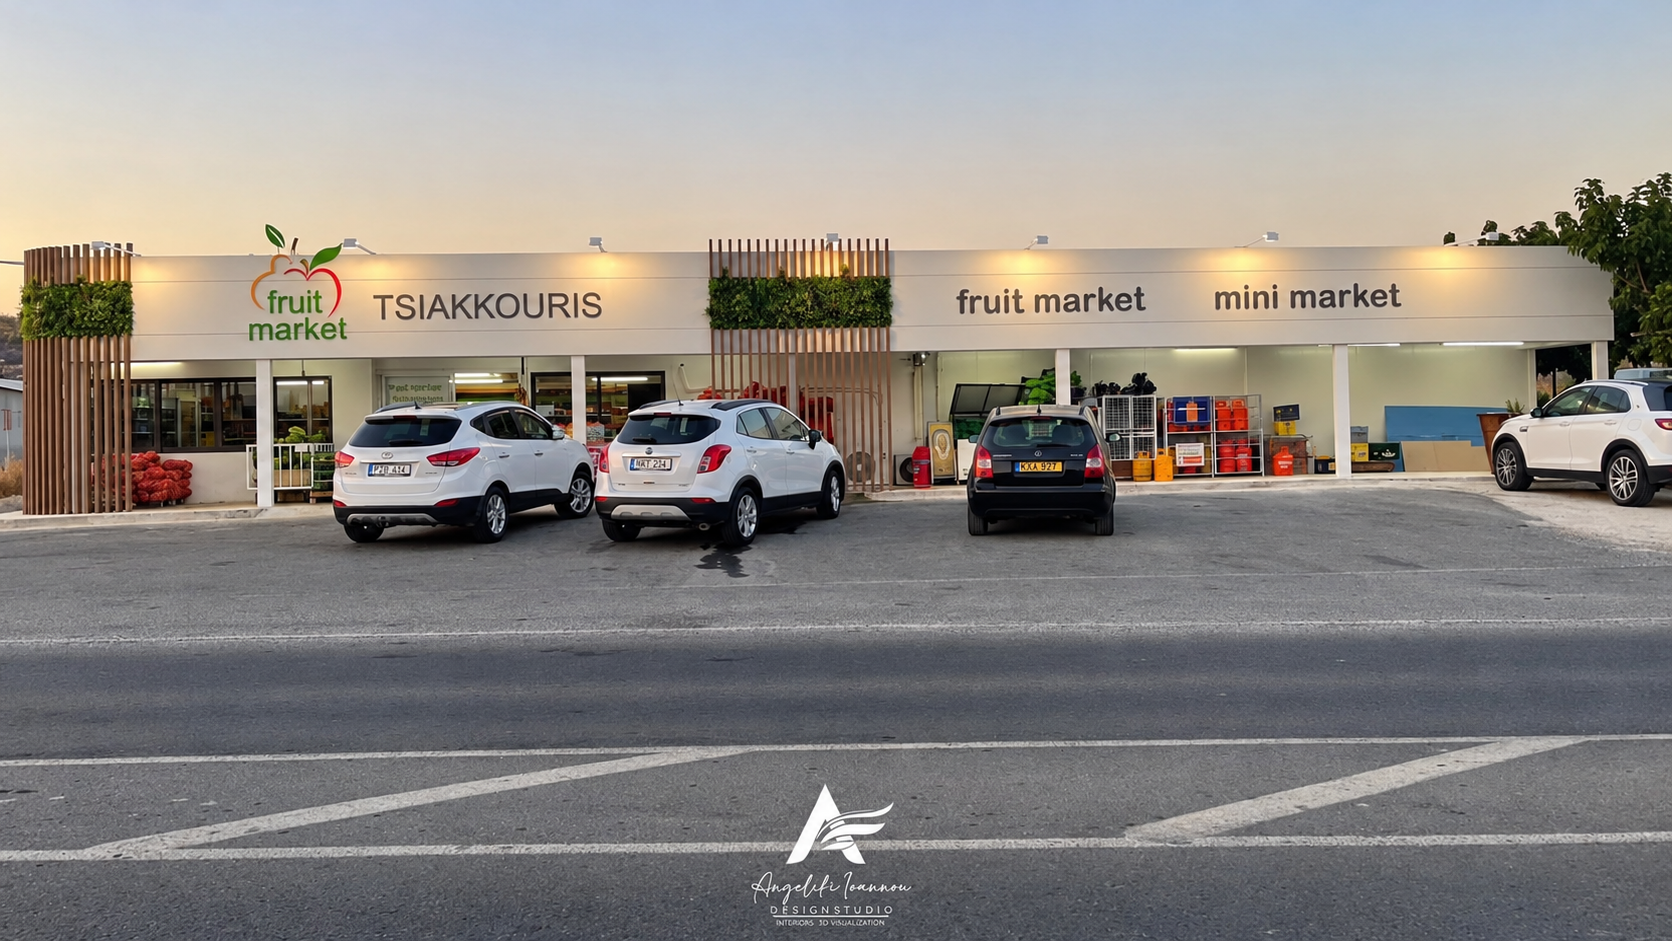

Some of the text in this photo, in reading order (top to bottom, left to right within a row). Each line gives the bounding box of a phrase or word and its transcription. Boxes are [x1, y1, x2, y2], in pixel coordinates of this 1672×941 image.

[267, 290, 323, 314] fruit
[373, 292, 602, 321] TSIAKKOURIS
[956, 286, 1147, 315] fruit market
[1214, 282, 1402, 311] mini market
[248, 317, 347, 341] market
[1020, 462, 1057, 471] KXA 927
